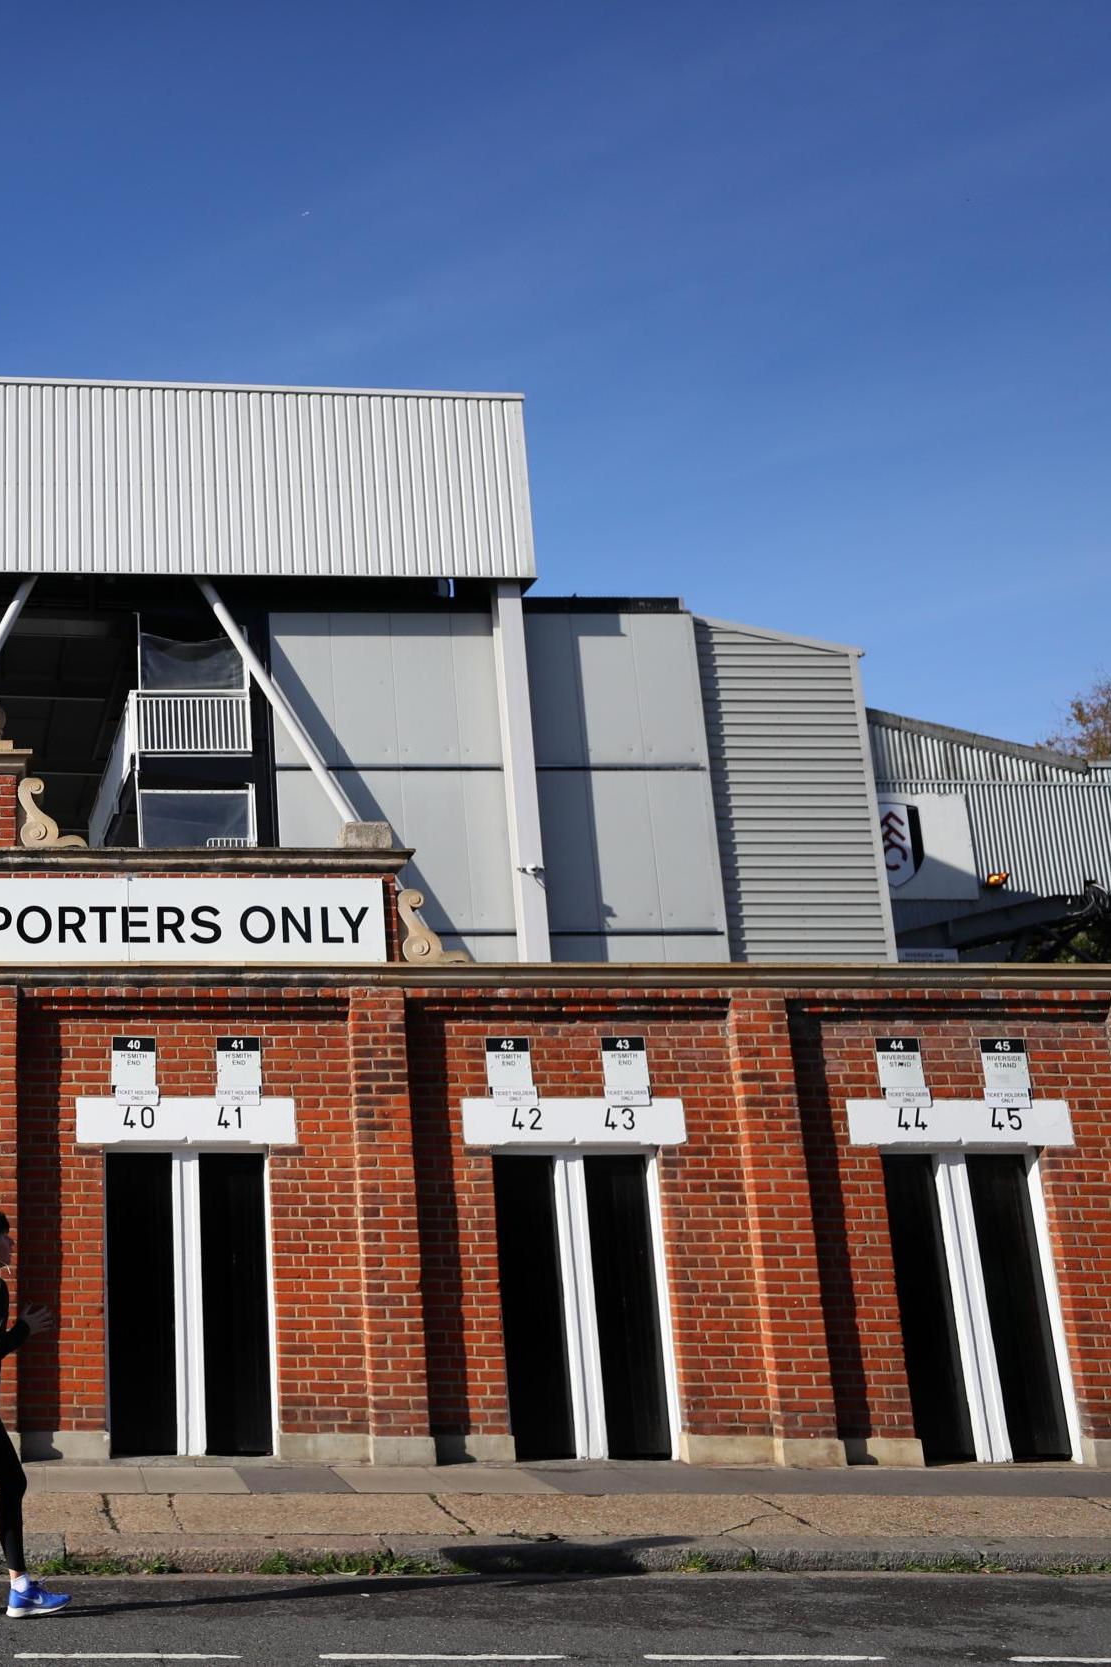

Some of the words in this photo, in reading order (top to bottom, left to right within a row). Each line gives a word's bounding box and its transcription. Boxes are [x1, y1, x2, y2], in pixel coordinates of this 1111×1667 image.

[239, 904, 369, 945] ONLY
[127, 1040, 140, 1049] 40
[231, 1040, 244, 1049] 41
[501, 1040, 514, 1050] 42
[616, 1040, 629, 1049] 43
[890, 1041, 903, 1050] 44
[995, 1042, 1010, 1051] 45
[123, 1107, 154, 1128] 40
[218, 1107, 242, 1128] 41
[512, 1108, 542, 1130] 42
[605, 1108, 635, 1130] 43
[898, 1108, 928, 1131] 44
[991, 1108, 1022, 1130] 45
